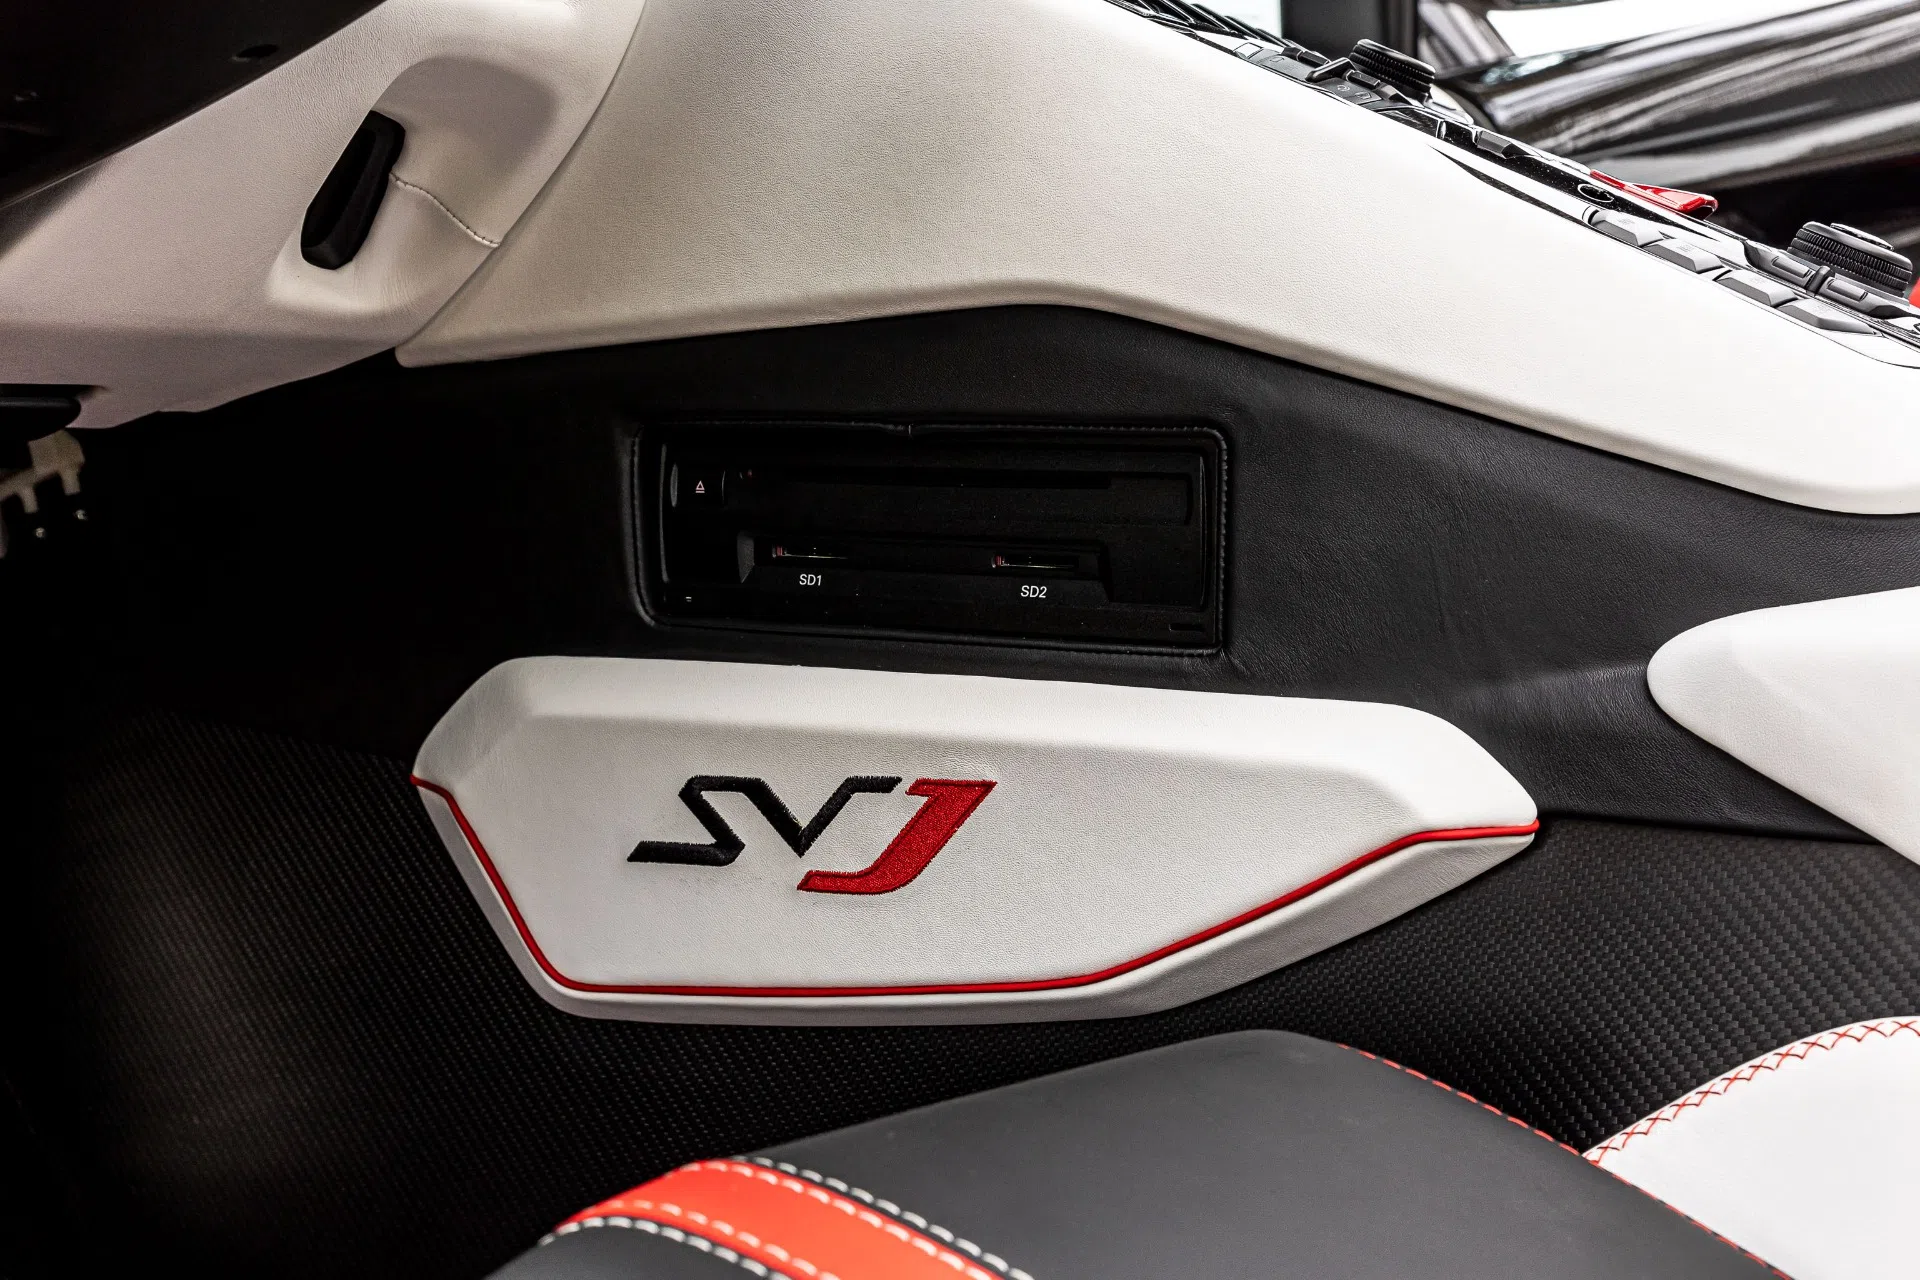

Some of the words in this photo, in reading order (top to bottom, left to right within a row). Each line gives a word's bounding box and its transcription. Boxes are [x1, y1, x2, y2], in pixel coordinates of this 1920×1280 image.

[799, 573, 822, 586] SD1
[1020, 585, 1047, 598] SD2
[627, 775, 998, 895] SVJ
